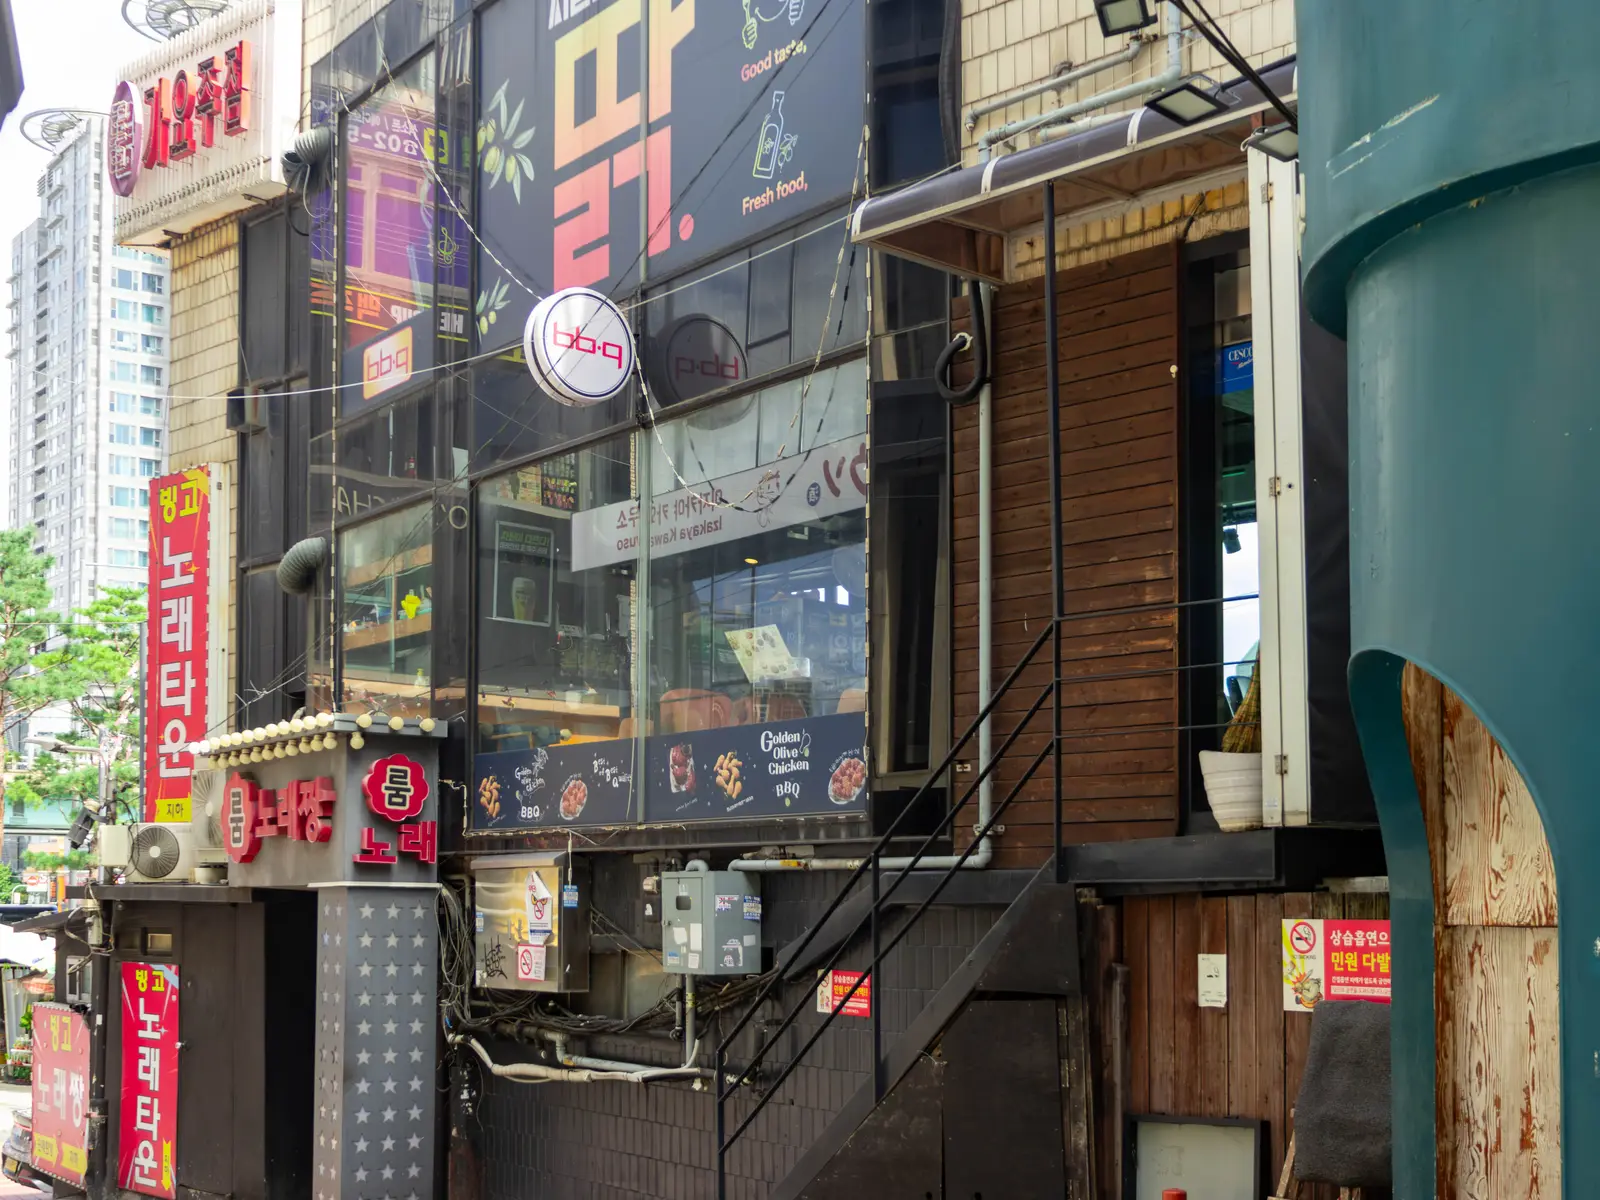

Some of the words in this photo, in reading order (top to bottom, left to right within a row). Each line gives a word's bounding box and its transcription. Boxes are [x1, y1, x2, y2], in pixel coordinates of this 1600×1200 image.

[741, 50, 771, 82] Good
[142, 40, 252, 170] 가요주점
[742, 185, 774, 216] Fresh
[776, 170, 808, 199] food,
[160, 479, 199, 524] 빙고
[160, 536, 196, 778] 노래타운
[760, 731, 800, 752] Golden
[772, 746, 798, 760] Olive
[768, 758, 809, 776] Chicken
[381, 765, 414, 810] 룸
[775, 781, 801, 799] BBQ
[230, 787, 246, 847] 룸
[521, 805, 540, 819] BBQ
[353, 820, 437, 865] 노래
[136, 969, 165, 993] 빙고
[1331, 951, 1358, 972] 민원
[50, 1014, 72, 1053] 빙고
[134, 997, 162, 1188] 노래타운
